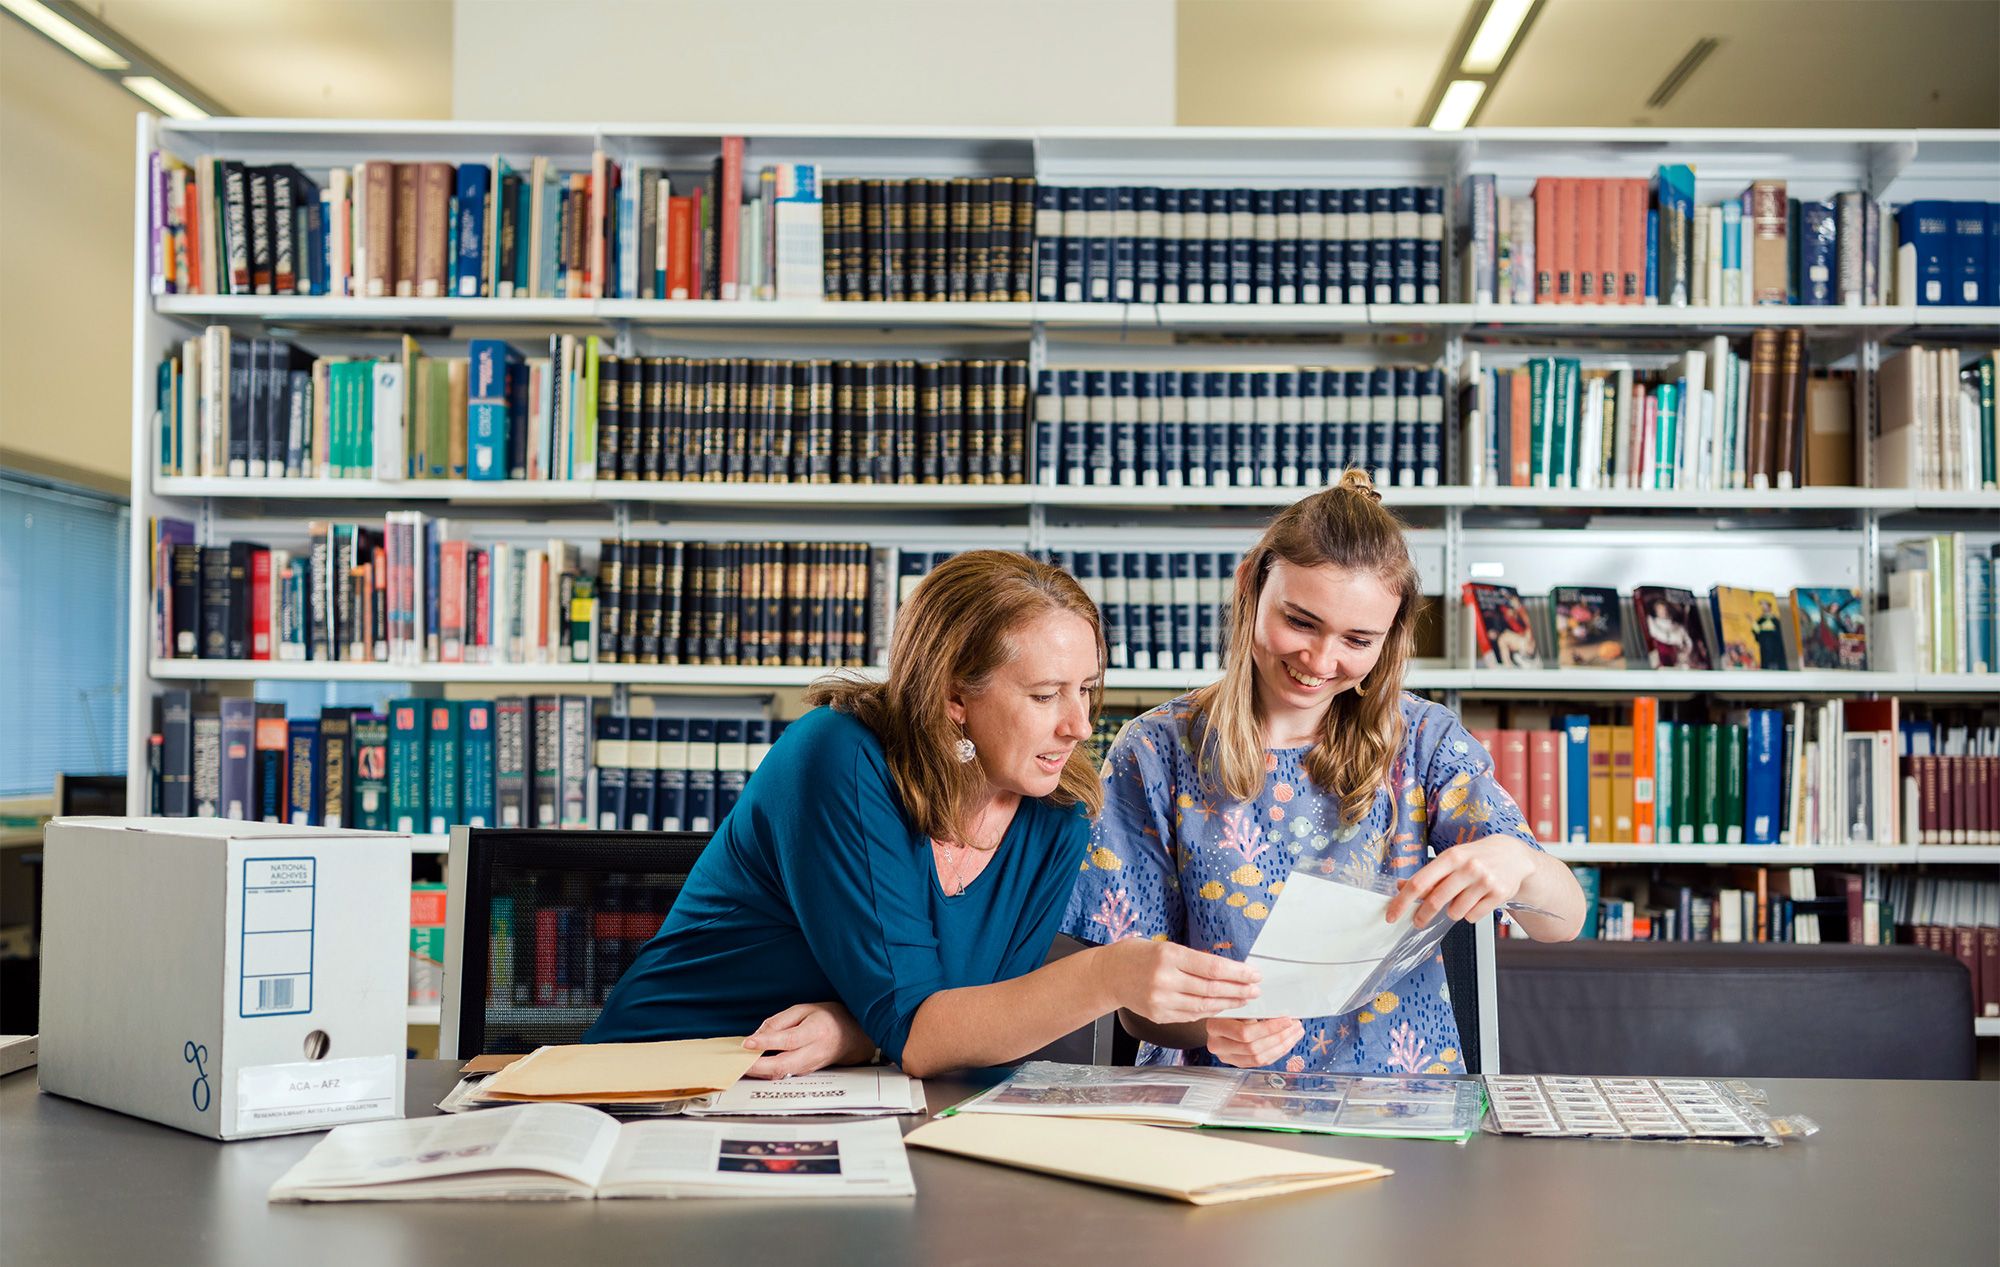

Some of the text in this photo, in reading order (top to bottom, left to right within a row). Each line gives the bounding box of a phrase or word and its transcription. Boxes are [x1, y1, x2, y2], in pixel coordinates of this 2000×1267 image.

[270, 863, 307, 872] NATIONAL
[270, 871, 308, 880] ARCHIVES
[289, 1081, 311, 1092] ACA
[320, 1079, 341, 1090] AFZ
